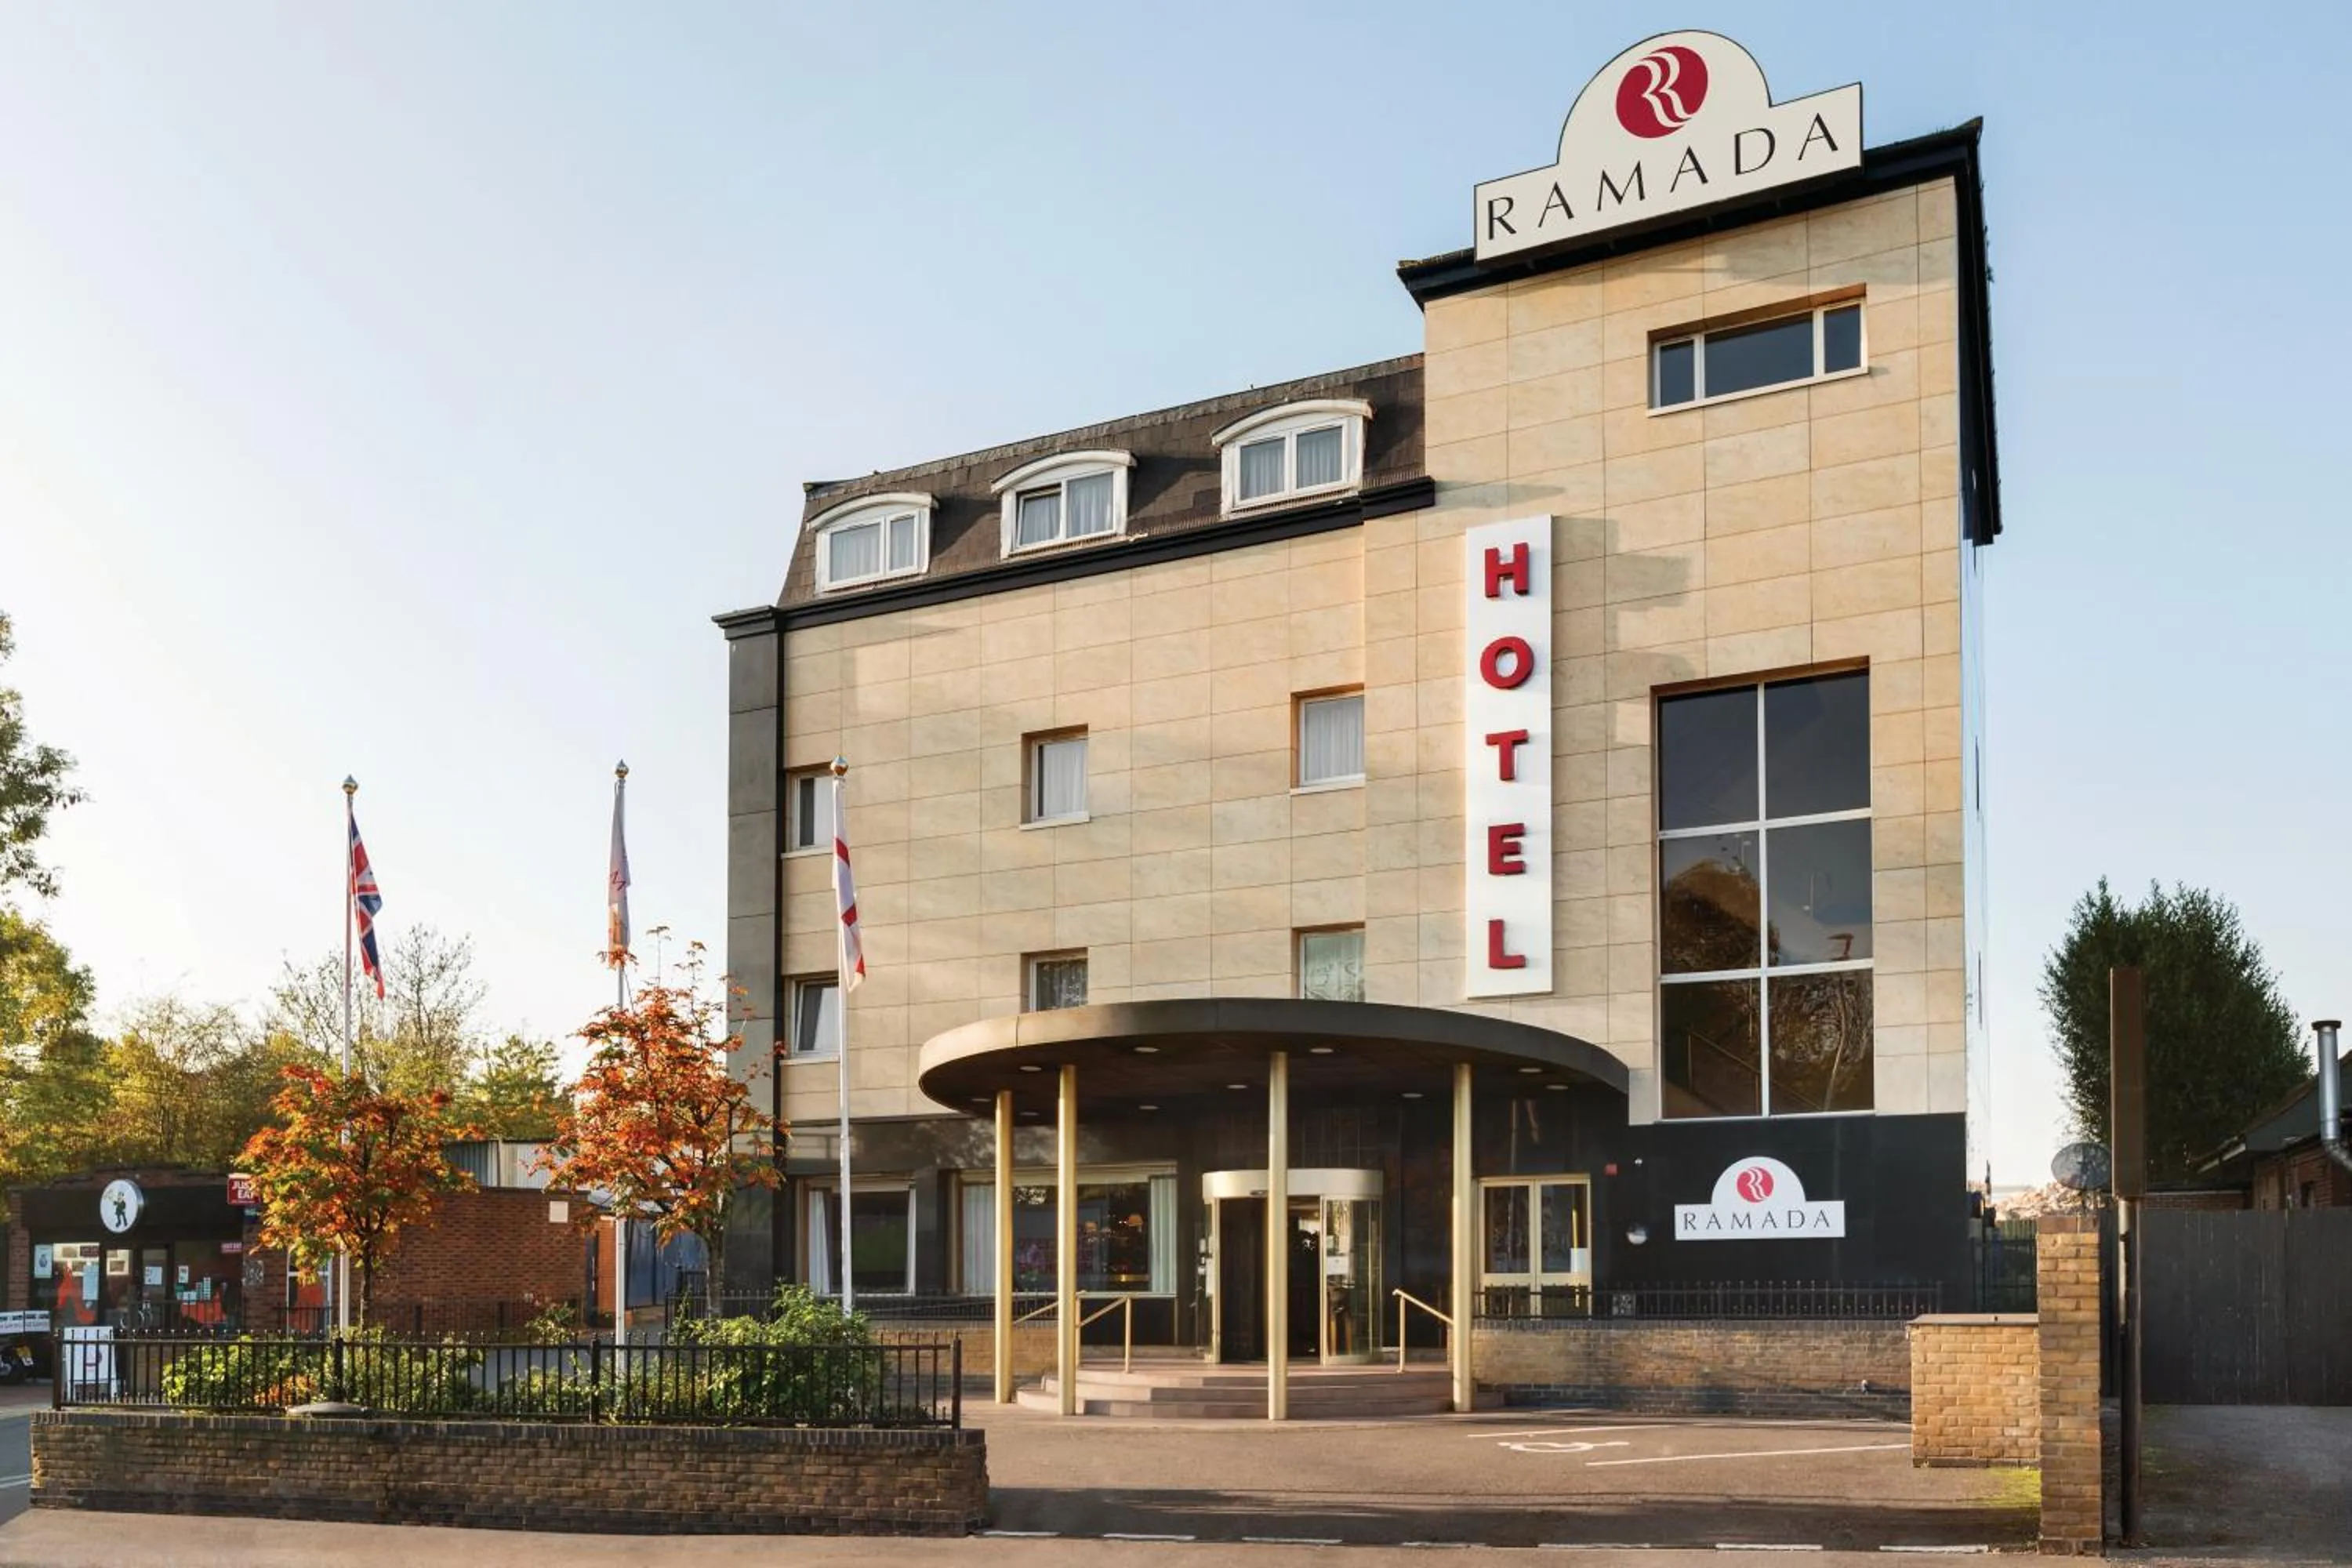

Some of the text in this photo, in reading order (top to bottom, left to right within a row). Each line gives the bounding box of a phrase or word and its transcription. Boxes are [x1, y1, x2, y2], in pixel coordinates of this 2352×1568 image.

[1487, 112, 1839, 240] RAMADA
[1479, 543, 1534, 969] HOTEL
[1682, 1209, 1831, 1231] RAMADA
